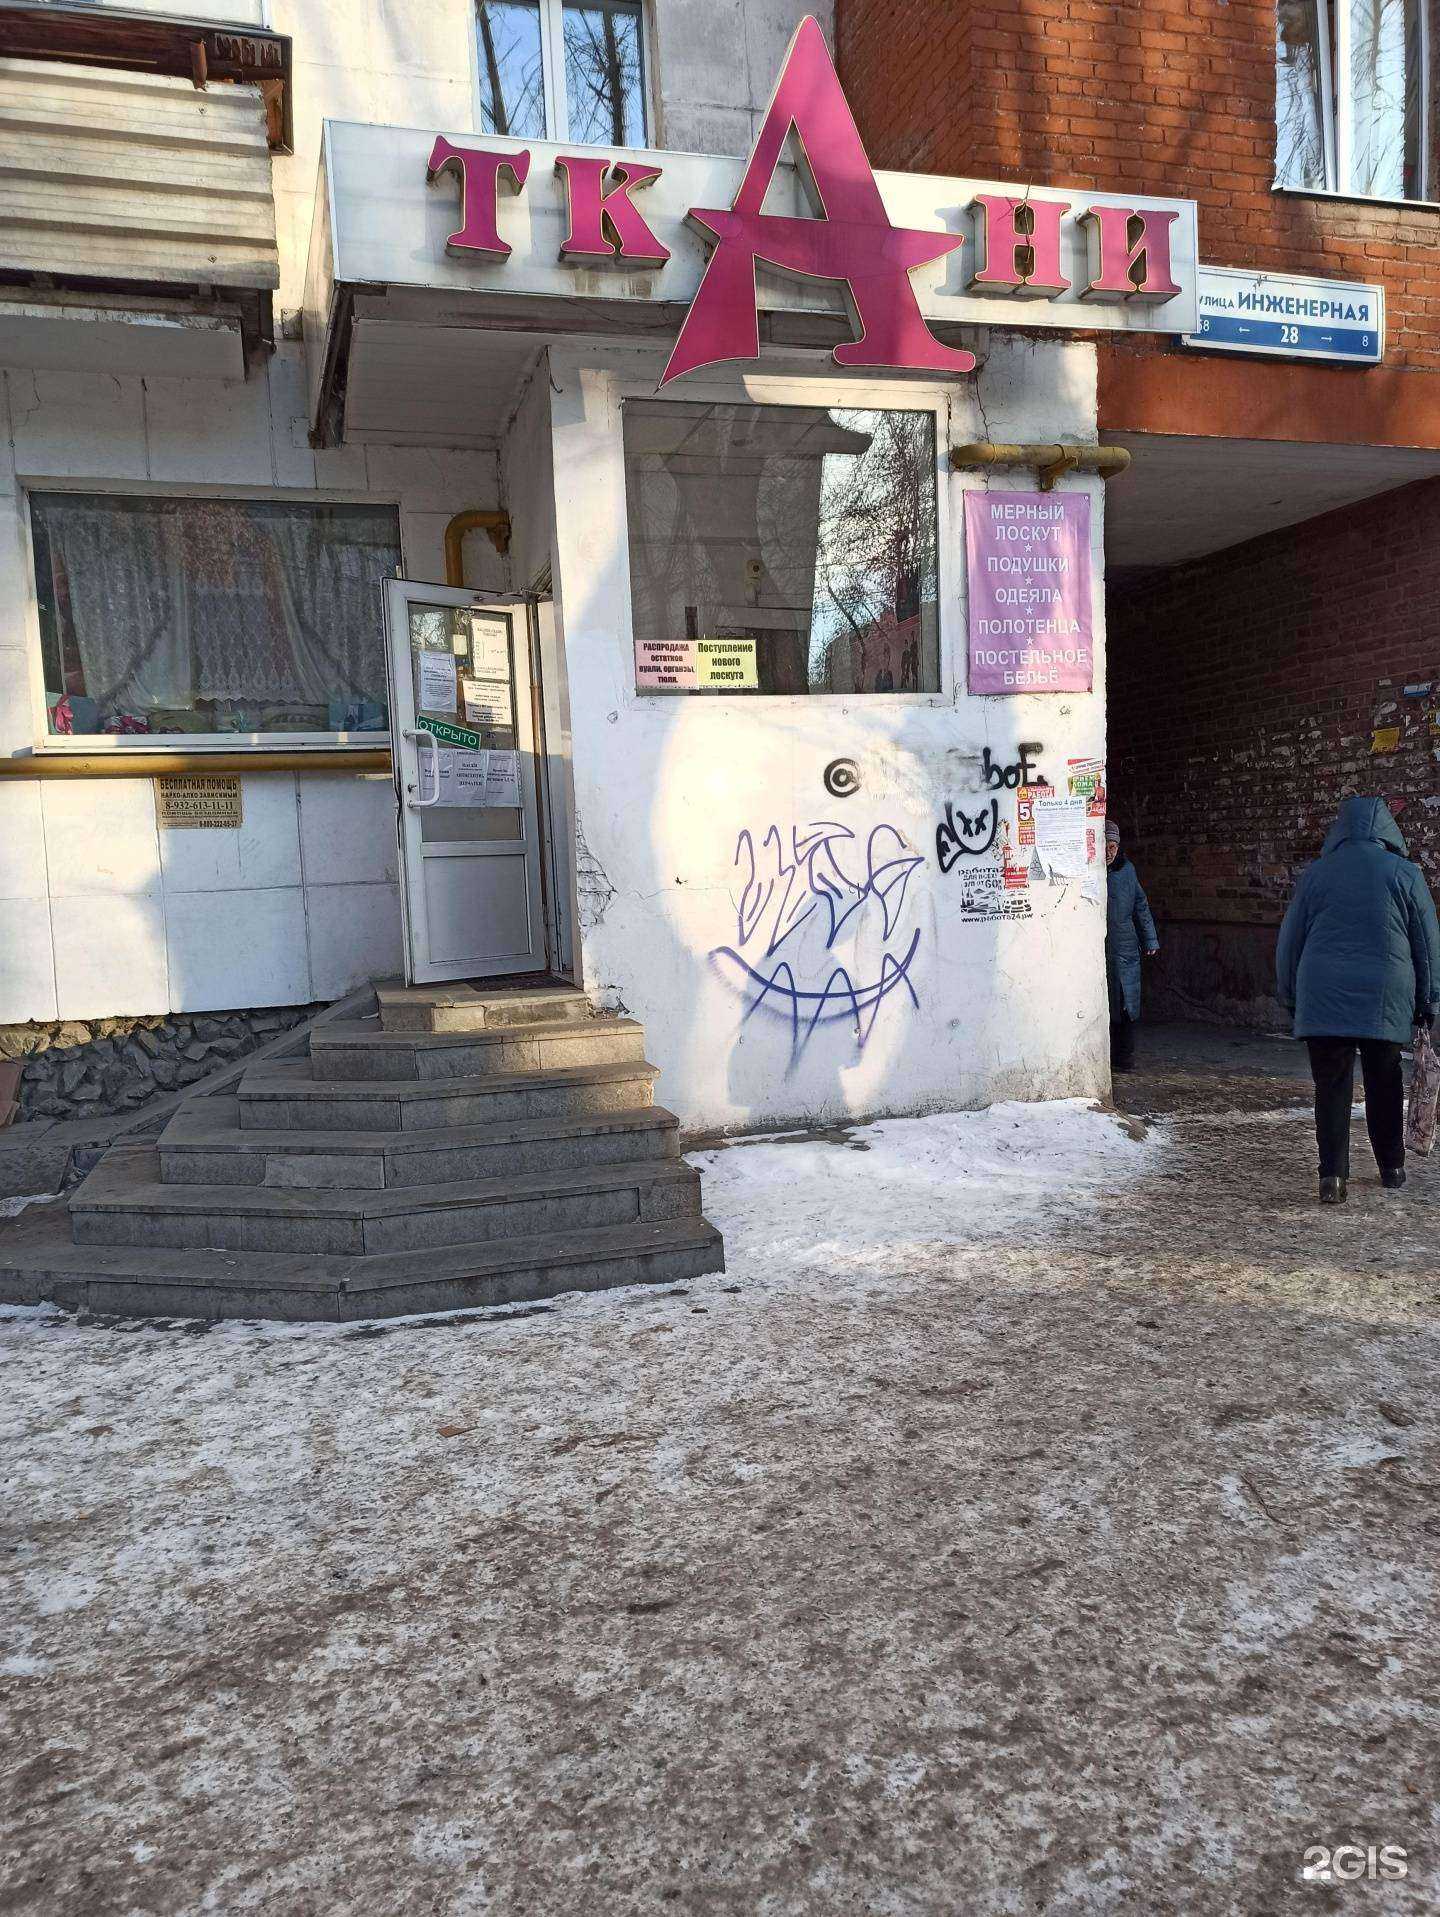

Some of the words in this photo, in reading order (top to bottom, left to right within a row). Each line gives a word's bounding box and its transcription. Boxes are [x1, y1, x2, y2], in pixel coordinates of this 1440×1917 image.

[1238, 291, 1369, 322] ИНЖЕНЕРНАЯ
[1280, 325, 1299, 344] 28
[1362, 335, 1369, 347] 8
[991, 503, 1065, 520] МЕРНЫЙ
[995, 526, 1061, 541] ЛОСКУТ
[987, 557, 1069, 575] ПОДУШКИ
[995, 589, 1063, 605] ОДЕЯЛА
[978, 619, 1081, 635] ПОЛОТЕНЦА
[643, 643, 690, 652] РАСПРОДАЖА
[698, 643, 753, 653] Поступление
[712, 658, 741, 666] нового
[975, 649, 1088, 665] ПОСТЕЛЬНОЕ
[710, 672, 744, 680] лоскута
[419, 720, 477, 745] ОТКРЫТО
[160, 779, 206, 790] БЕСПЛАТНАЯ
[206, 779, 238, 791] ПОМОЩЬ
[165, 801, 233, 810] 8-932-613-11-11
